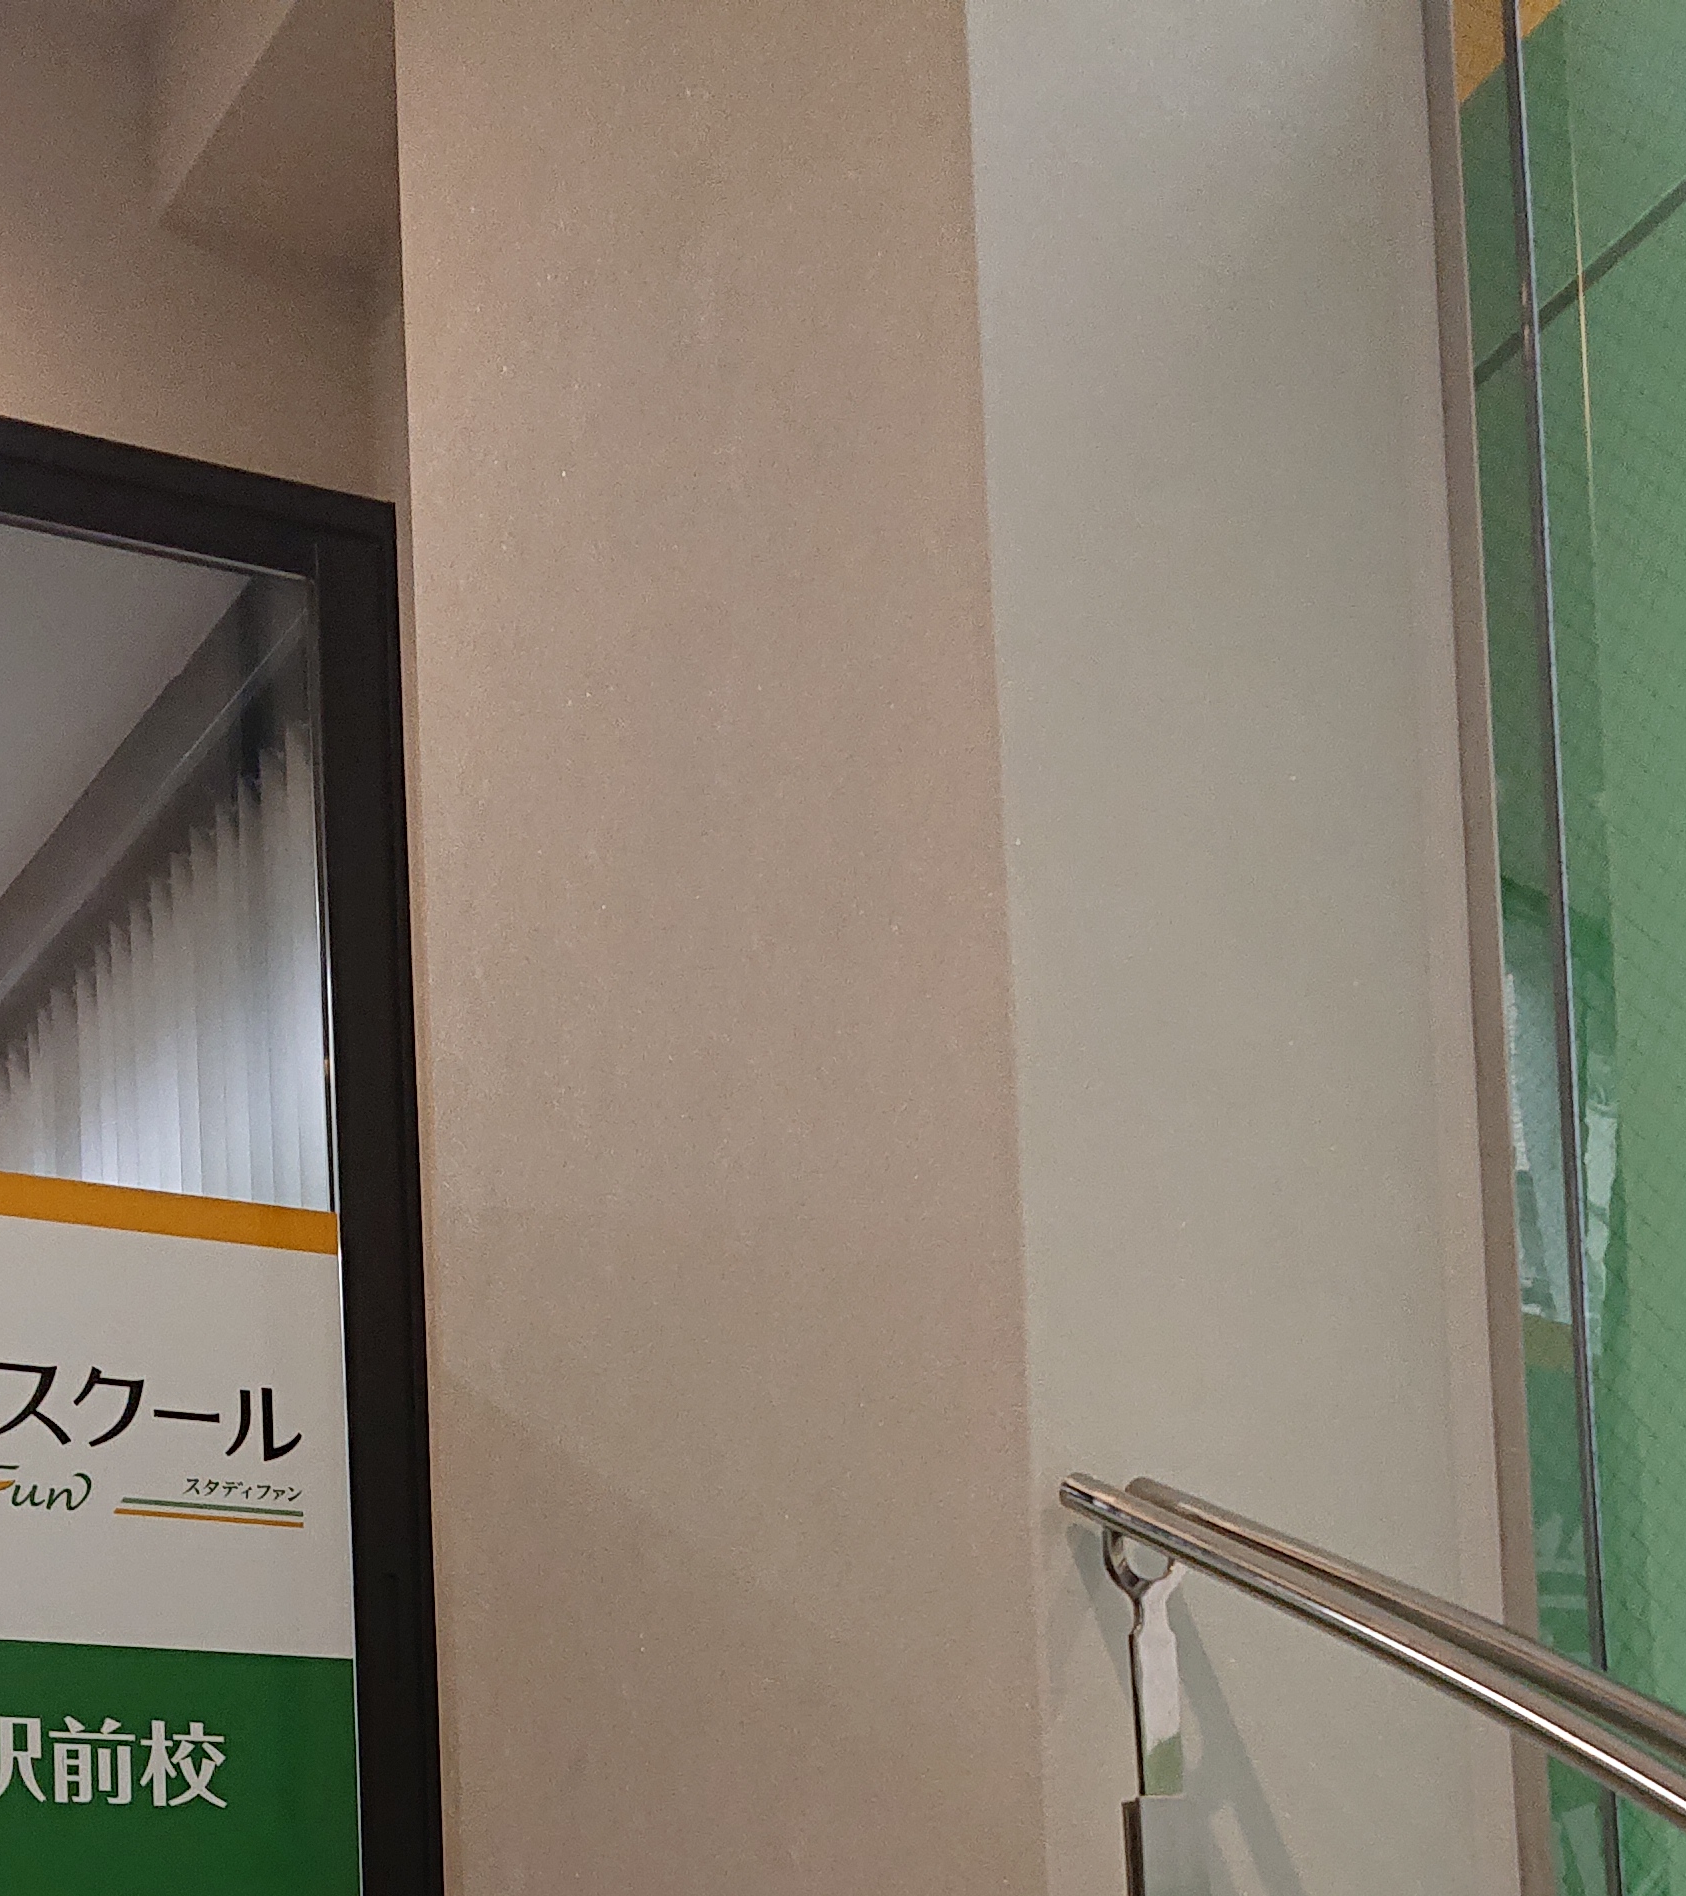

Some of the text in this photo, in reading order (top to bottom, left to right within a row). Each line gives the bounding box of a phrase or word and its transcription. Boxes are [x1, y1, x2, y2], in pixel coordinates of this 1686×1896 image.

[185, 1477, 303, 1503] スタディファン
